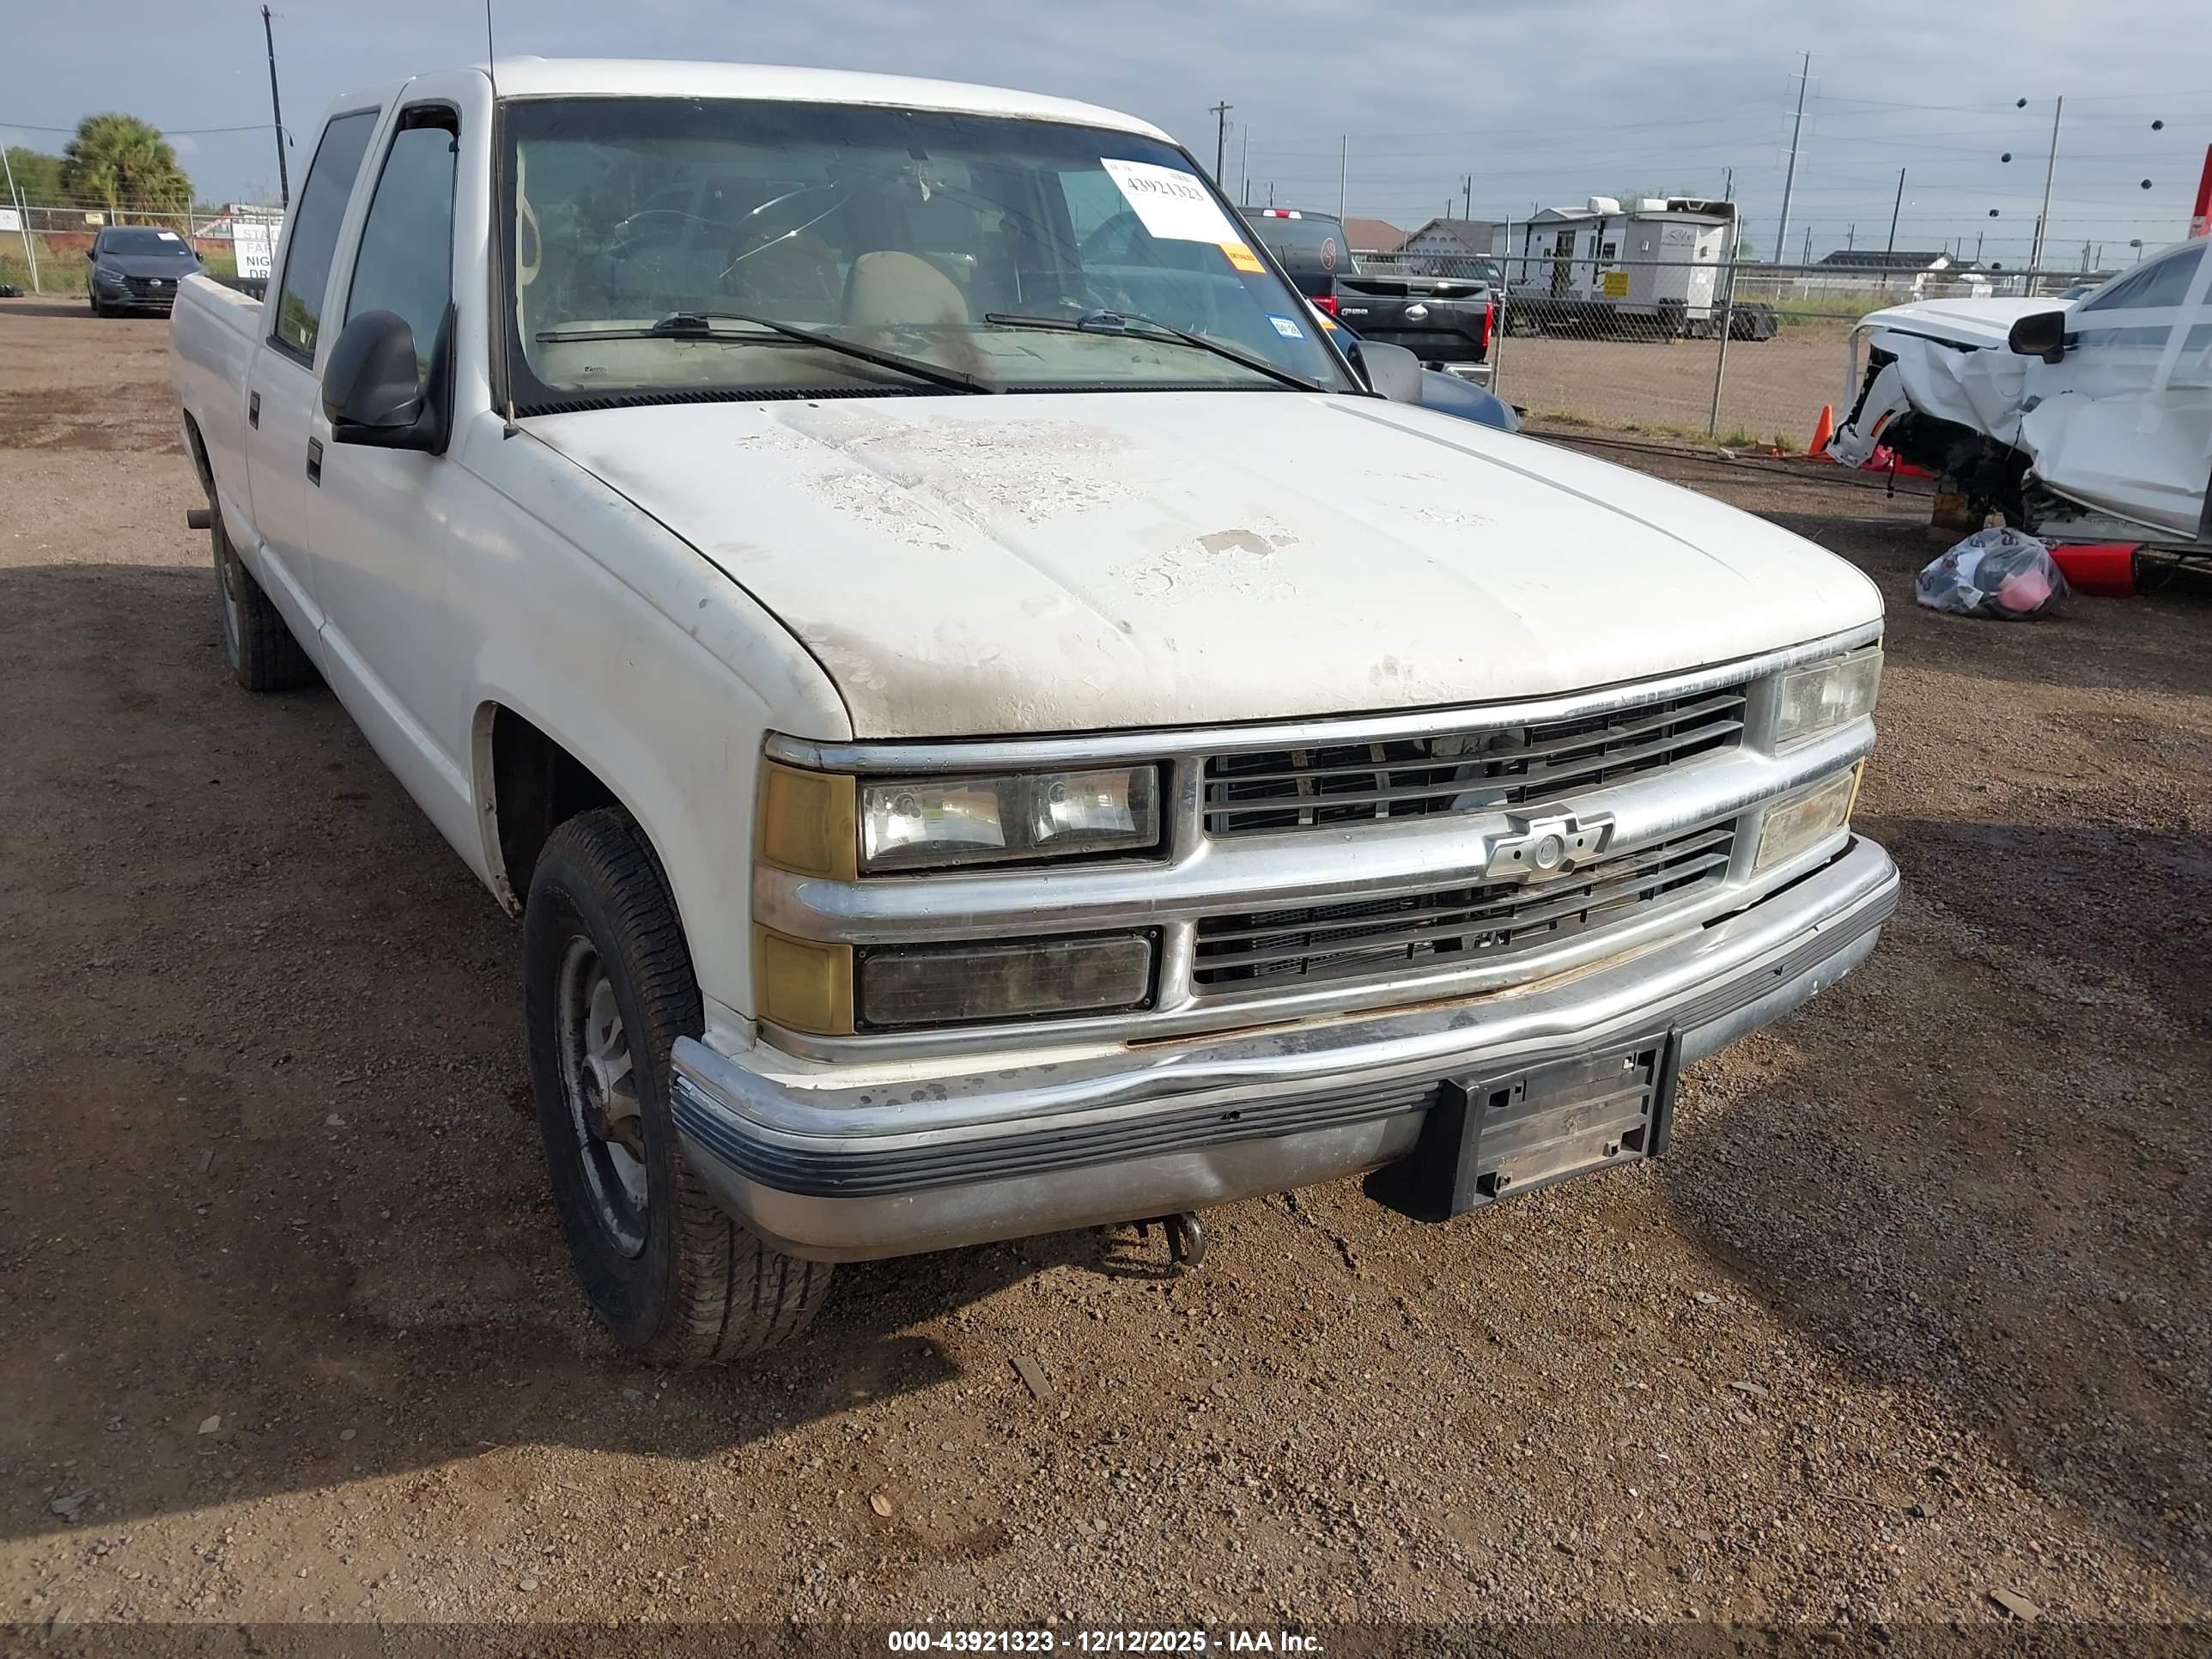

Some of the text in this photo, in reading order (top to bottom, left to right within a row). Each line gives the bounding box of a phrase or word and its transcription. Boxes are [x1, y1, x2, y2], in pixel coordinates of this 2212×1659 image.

[1128, 178, 1204, 201] 43921323
[246, 256, 270, 266] NIG
[249, 270, 268, 279] DR
